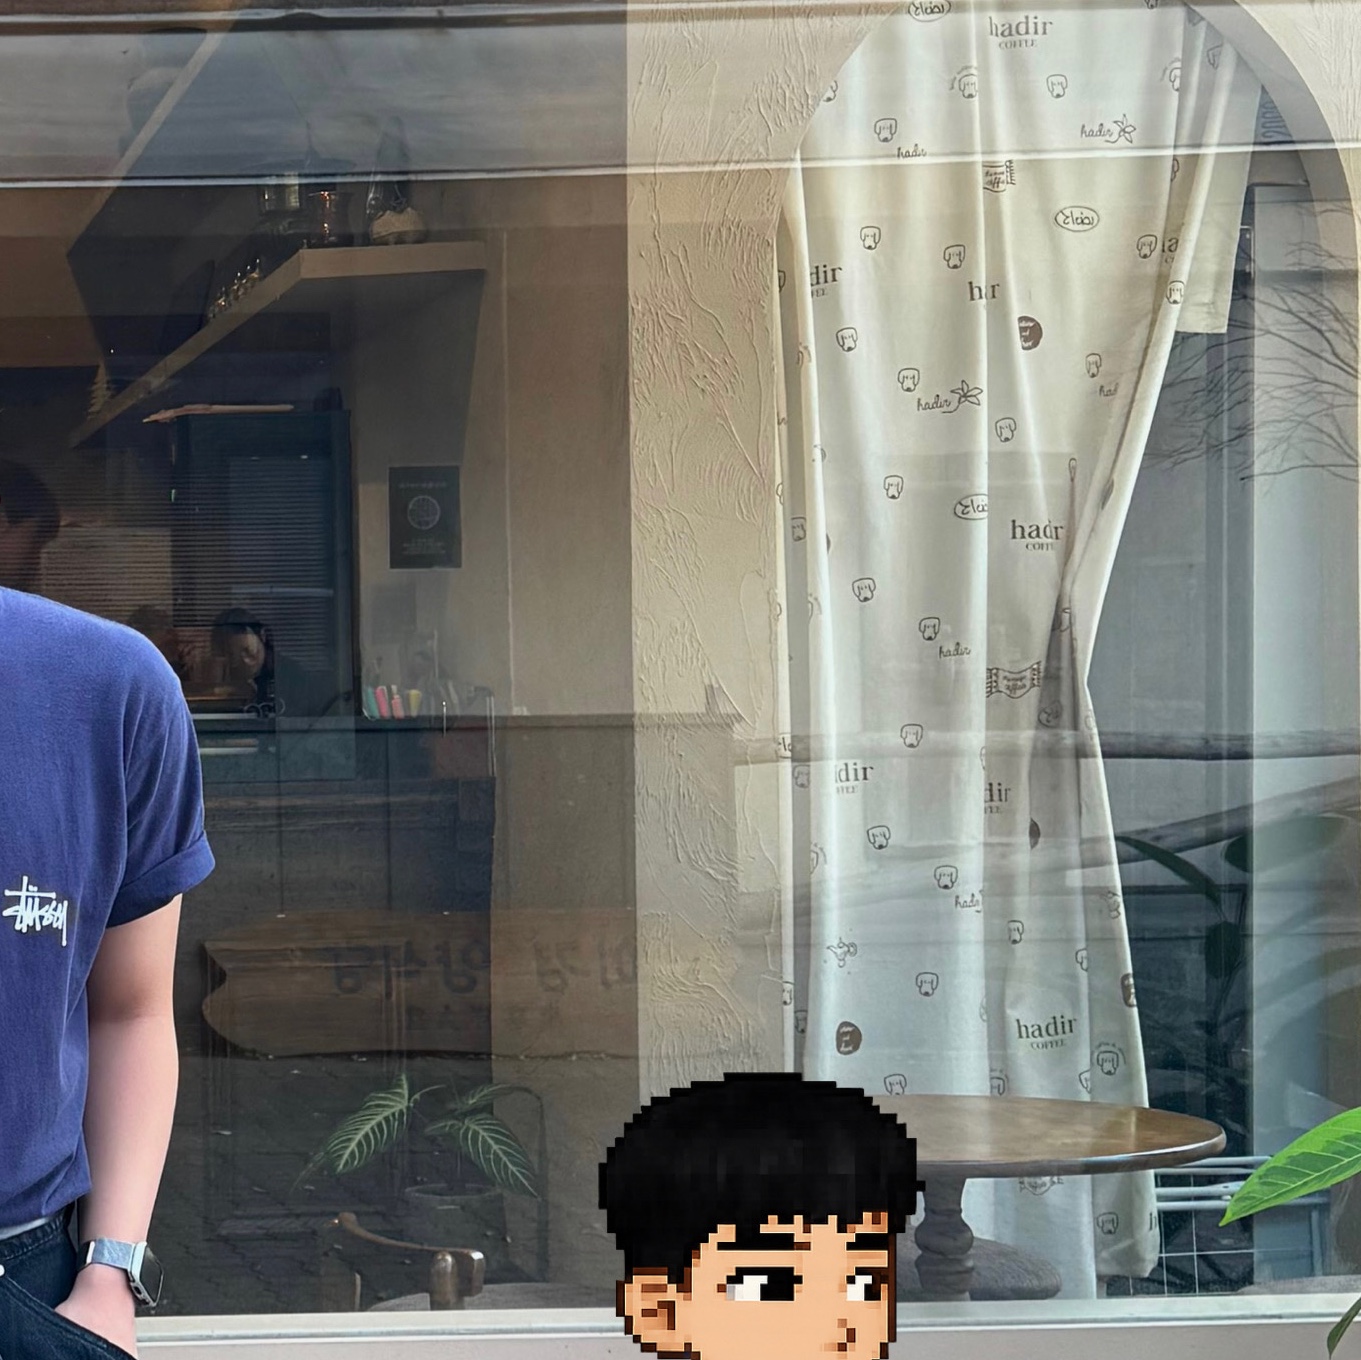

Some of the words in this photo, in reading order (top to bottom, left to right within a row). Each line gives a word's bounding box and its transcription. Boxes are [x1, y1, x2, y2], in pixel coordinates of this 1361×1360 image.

[988, 15, 1053, 38] hadir
[916, 393, 951, 412] hadir
[939, 641, 971, 659] hadir
[835, 761, 875, 783] dir
[1015, 1015, 1077, 1039] hadir
